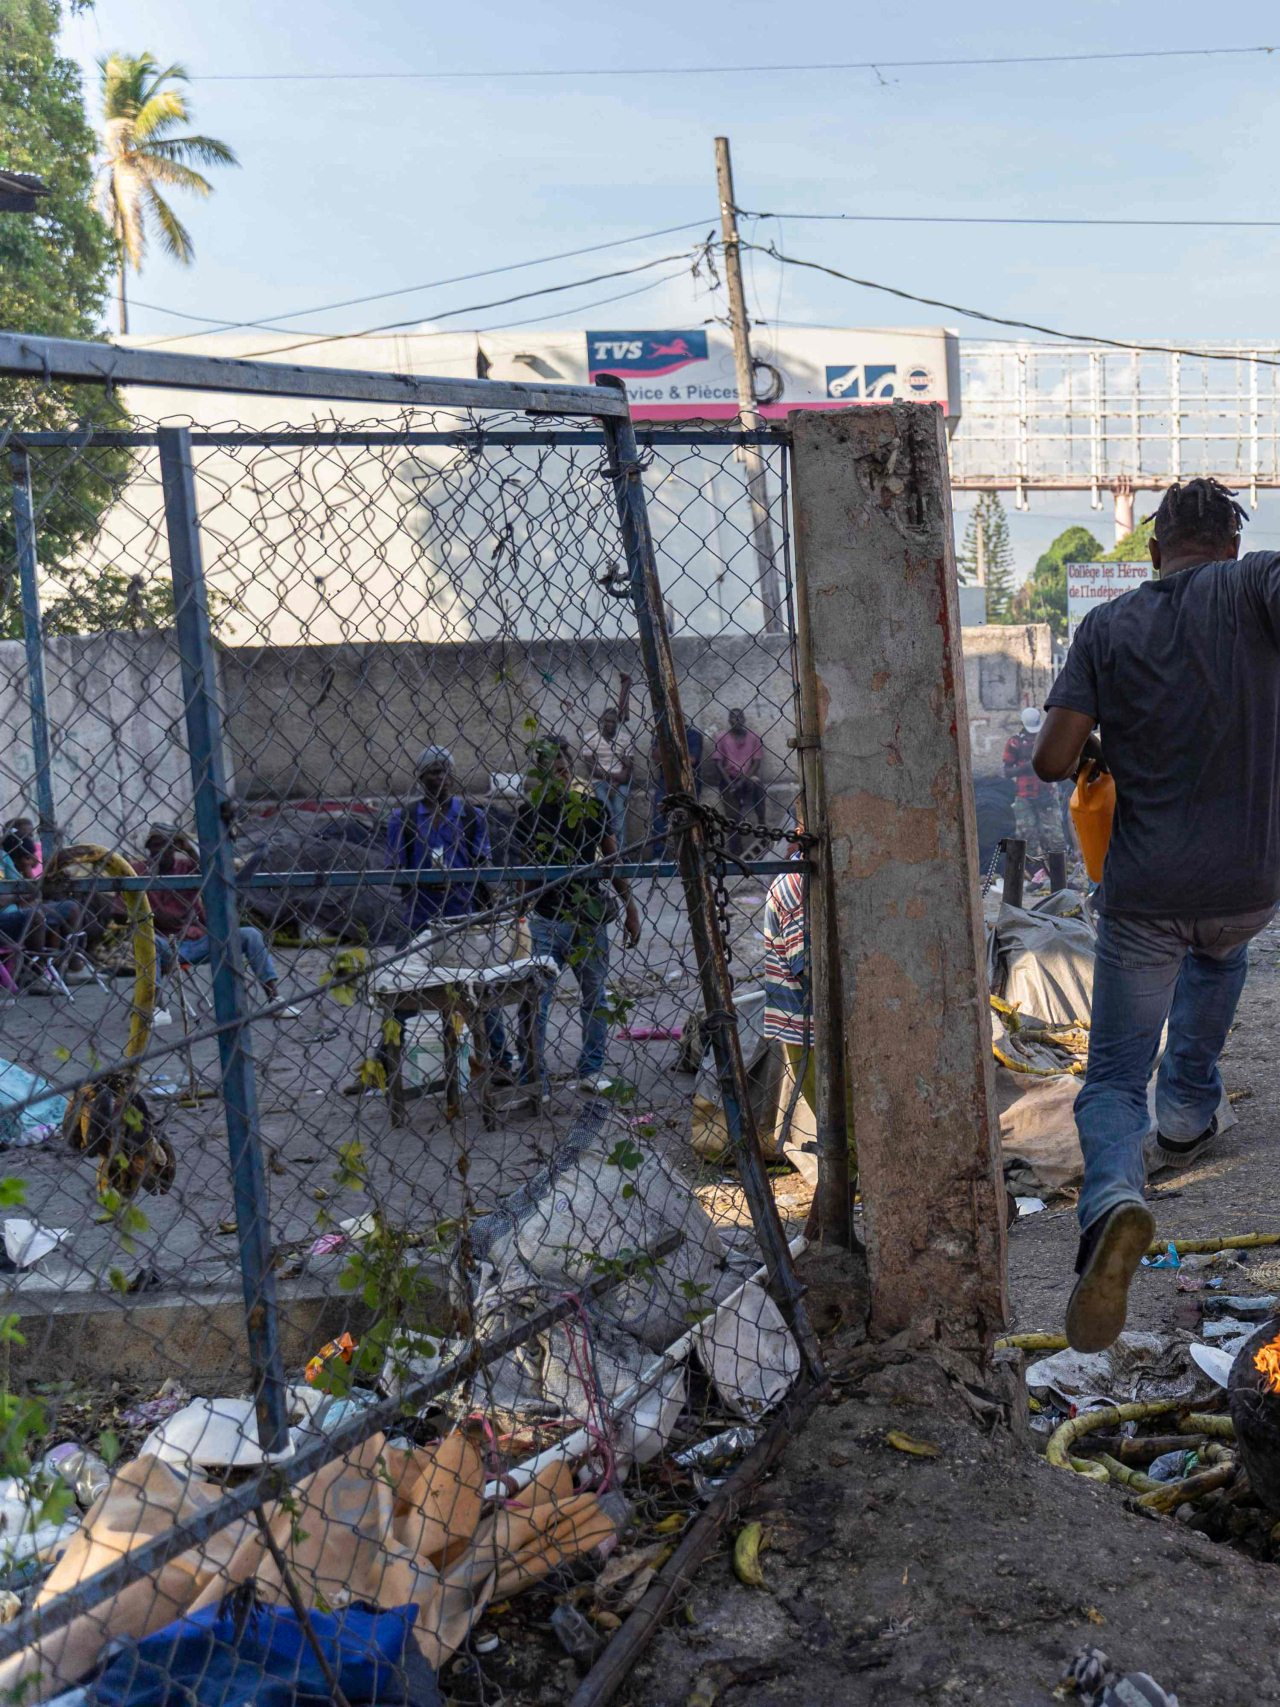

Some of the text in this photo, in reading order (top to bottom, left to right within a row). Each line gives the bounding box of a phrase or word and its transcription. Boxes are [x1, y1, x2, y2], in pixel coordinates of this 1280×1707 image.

[594, 341, 643, 360] TVS
[627, 386, 663, 399] rvice
[669, 386, 682, 399] &
[1117, 563, 1148, 578] Héros
